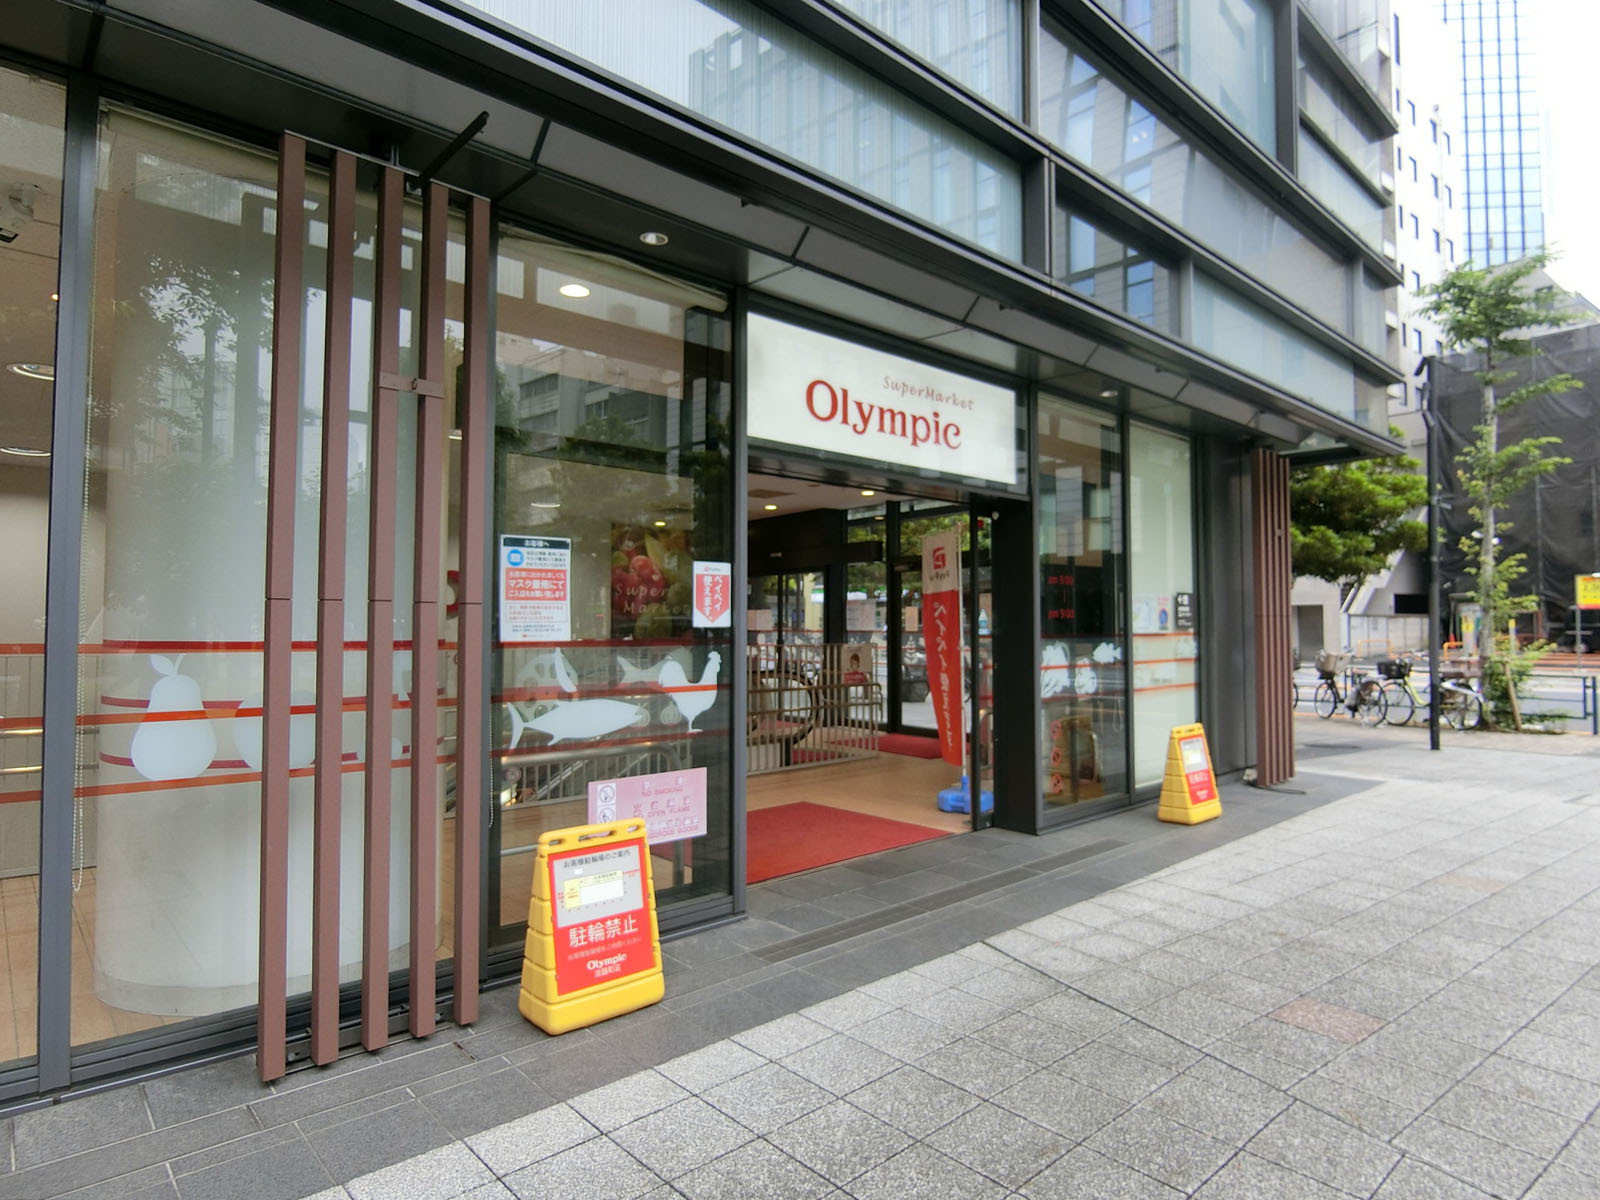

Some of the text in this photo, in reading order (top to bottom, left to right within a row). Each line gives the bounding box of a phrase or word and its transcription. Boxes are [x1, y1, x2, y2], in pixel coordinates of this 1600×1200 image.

[883, 376, 975, 411] SuperMarket
[805, 379, 962, 450] Olympic
[508, 579, 566, 590] マスク着用にて
[569, 914, 639, 947] 駐輪禁止
[587, 953, 628, 971] Olympic
